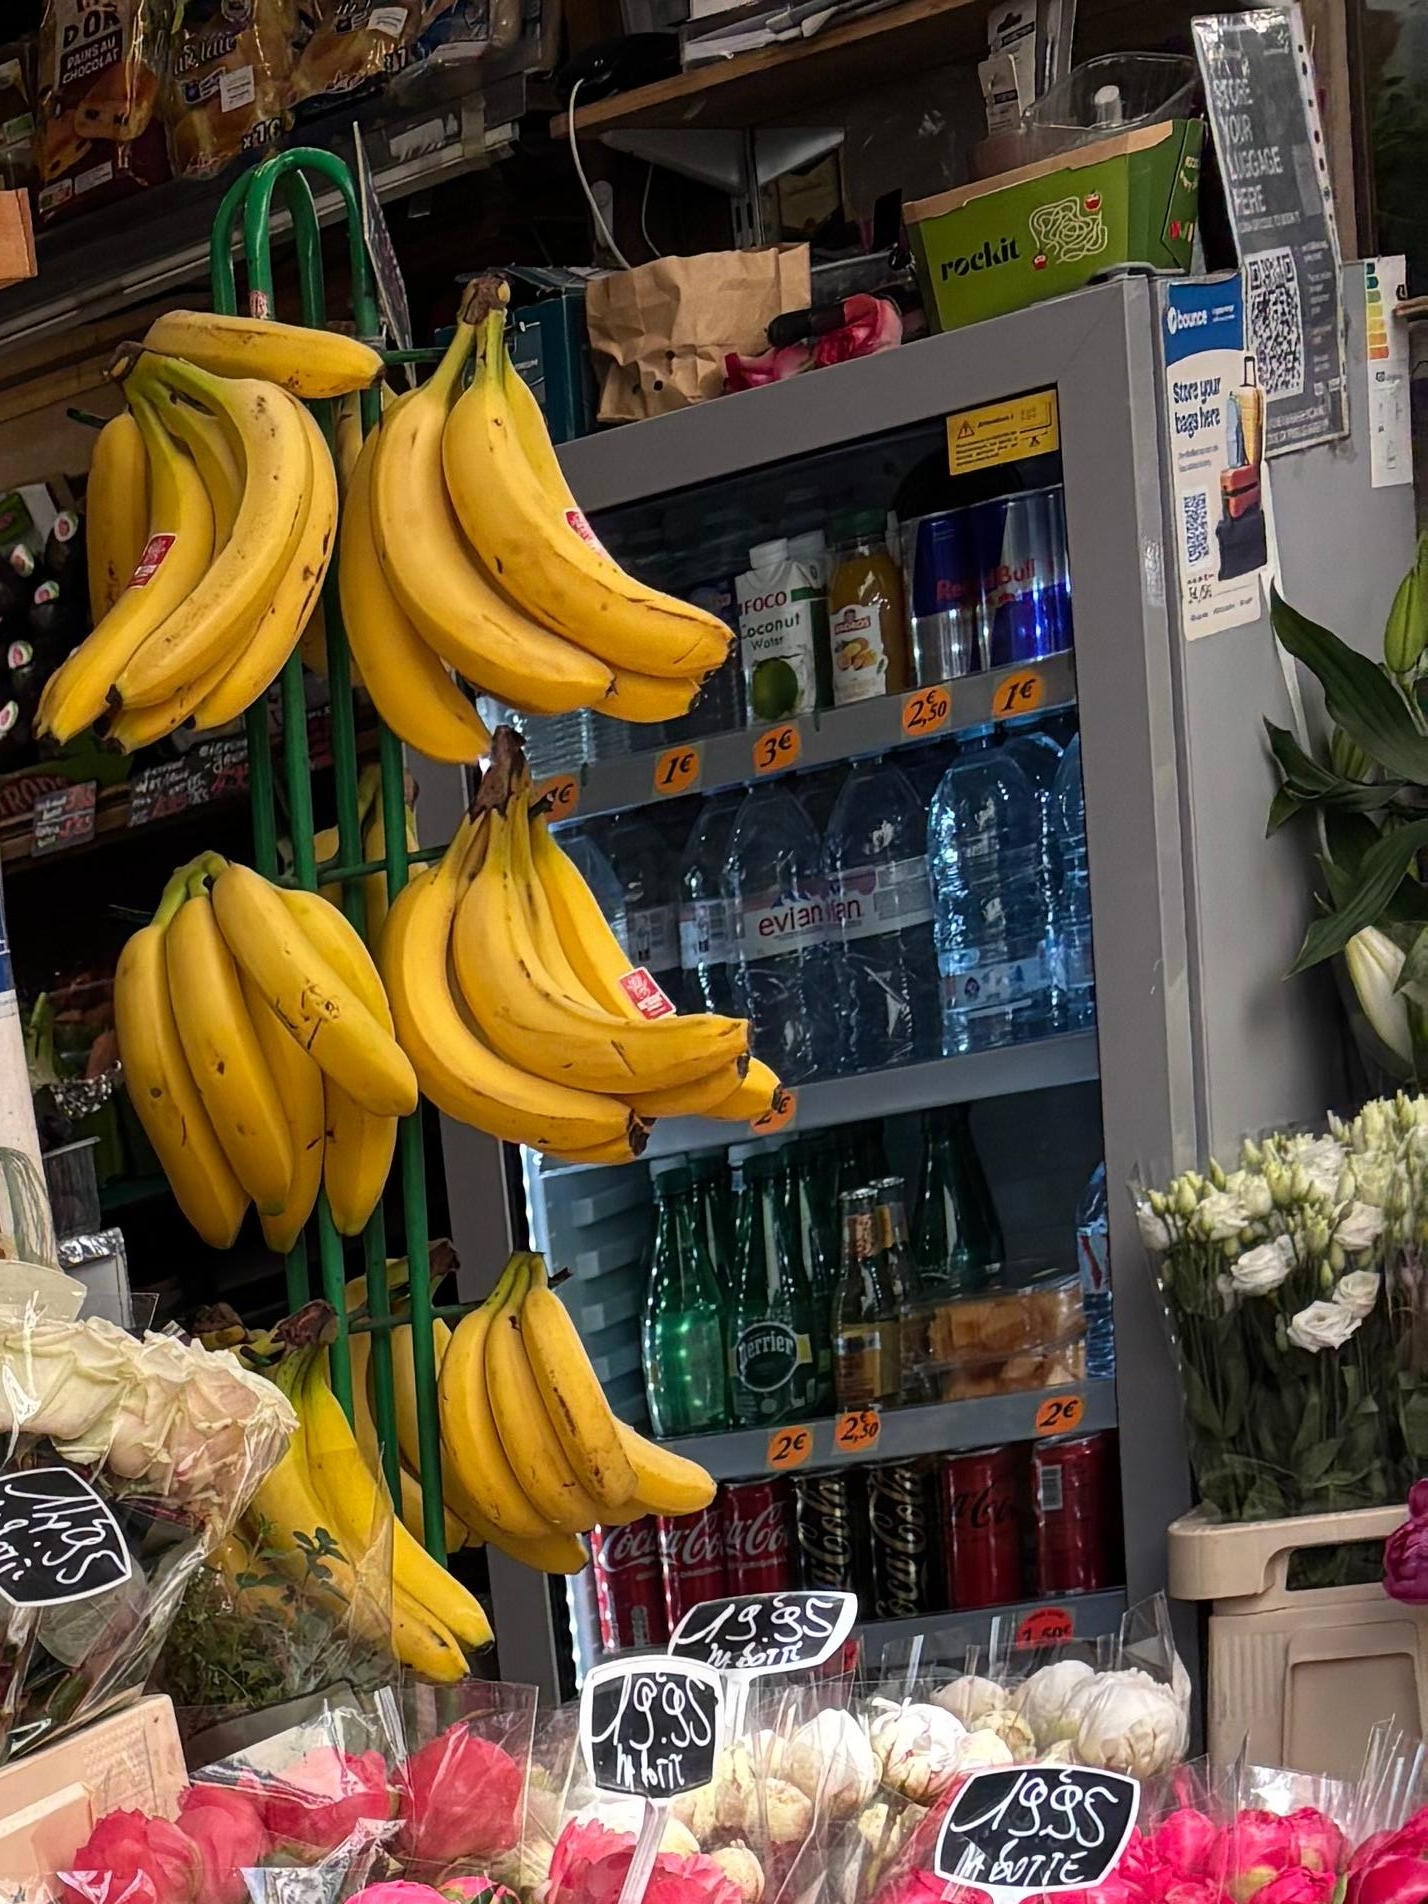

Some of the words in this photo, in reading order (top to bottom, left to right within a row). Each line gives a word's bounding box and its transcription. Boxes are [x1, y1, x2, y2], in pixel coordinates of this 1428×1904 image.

[62, 47, 120, 85] CHOCOLAT
[1218, 113, 1254, 144] YOUR
[1225, 146, 1284, 181] LUGGAGE
[940, 236, 1021, 281] rockit
[1177, 309, 1208, 329] bounce
[1173, 380, 1199, 404] Store
[1200, 377, 1221, 404] your
[1175, 410, 1199, 438] bags
[1200, 407, 1221, 430] here
[744, 590, 788, 617] FOCO
[1005, 675, 1038, 711] 1€
[759, 729, 793, 767] 3€
[664, 752, 696, 784] 1€
[757, 903, 824, 938] evian
[740, 1333, 794, 1365] Perrier
[1039, 1399, 1078, 1428] 2€
[772, 1432, 807, 1462] 2€
